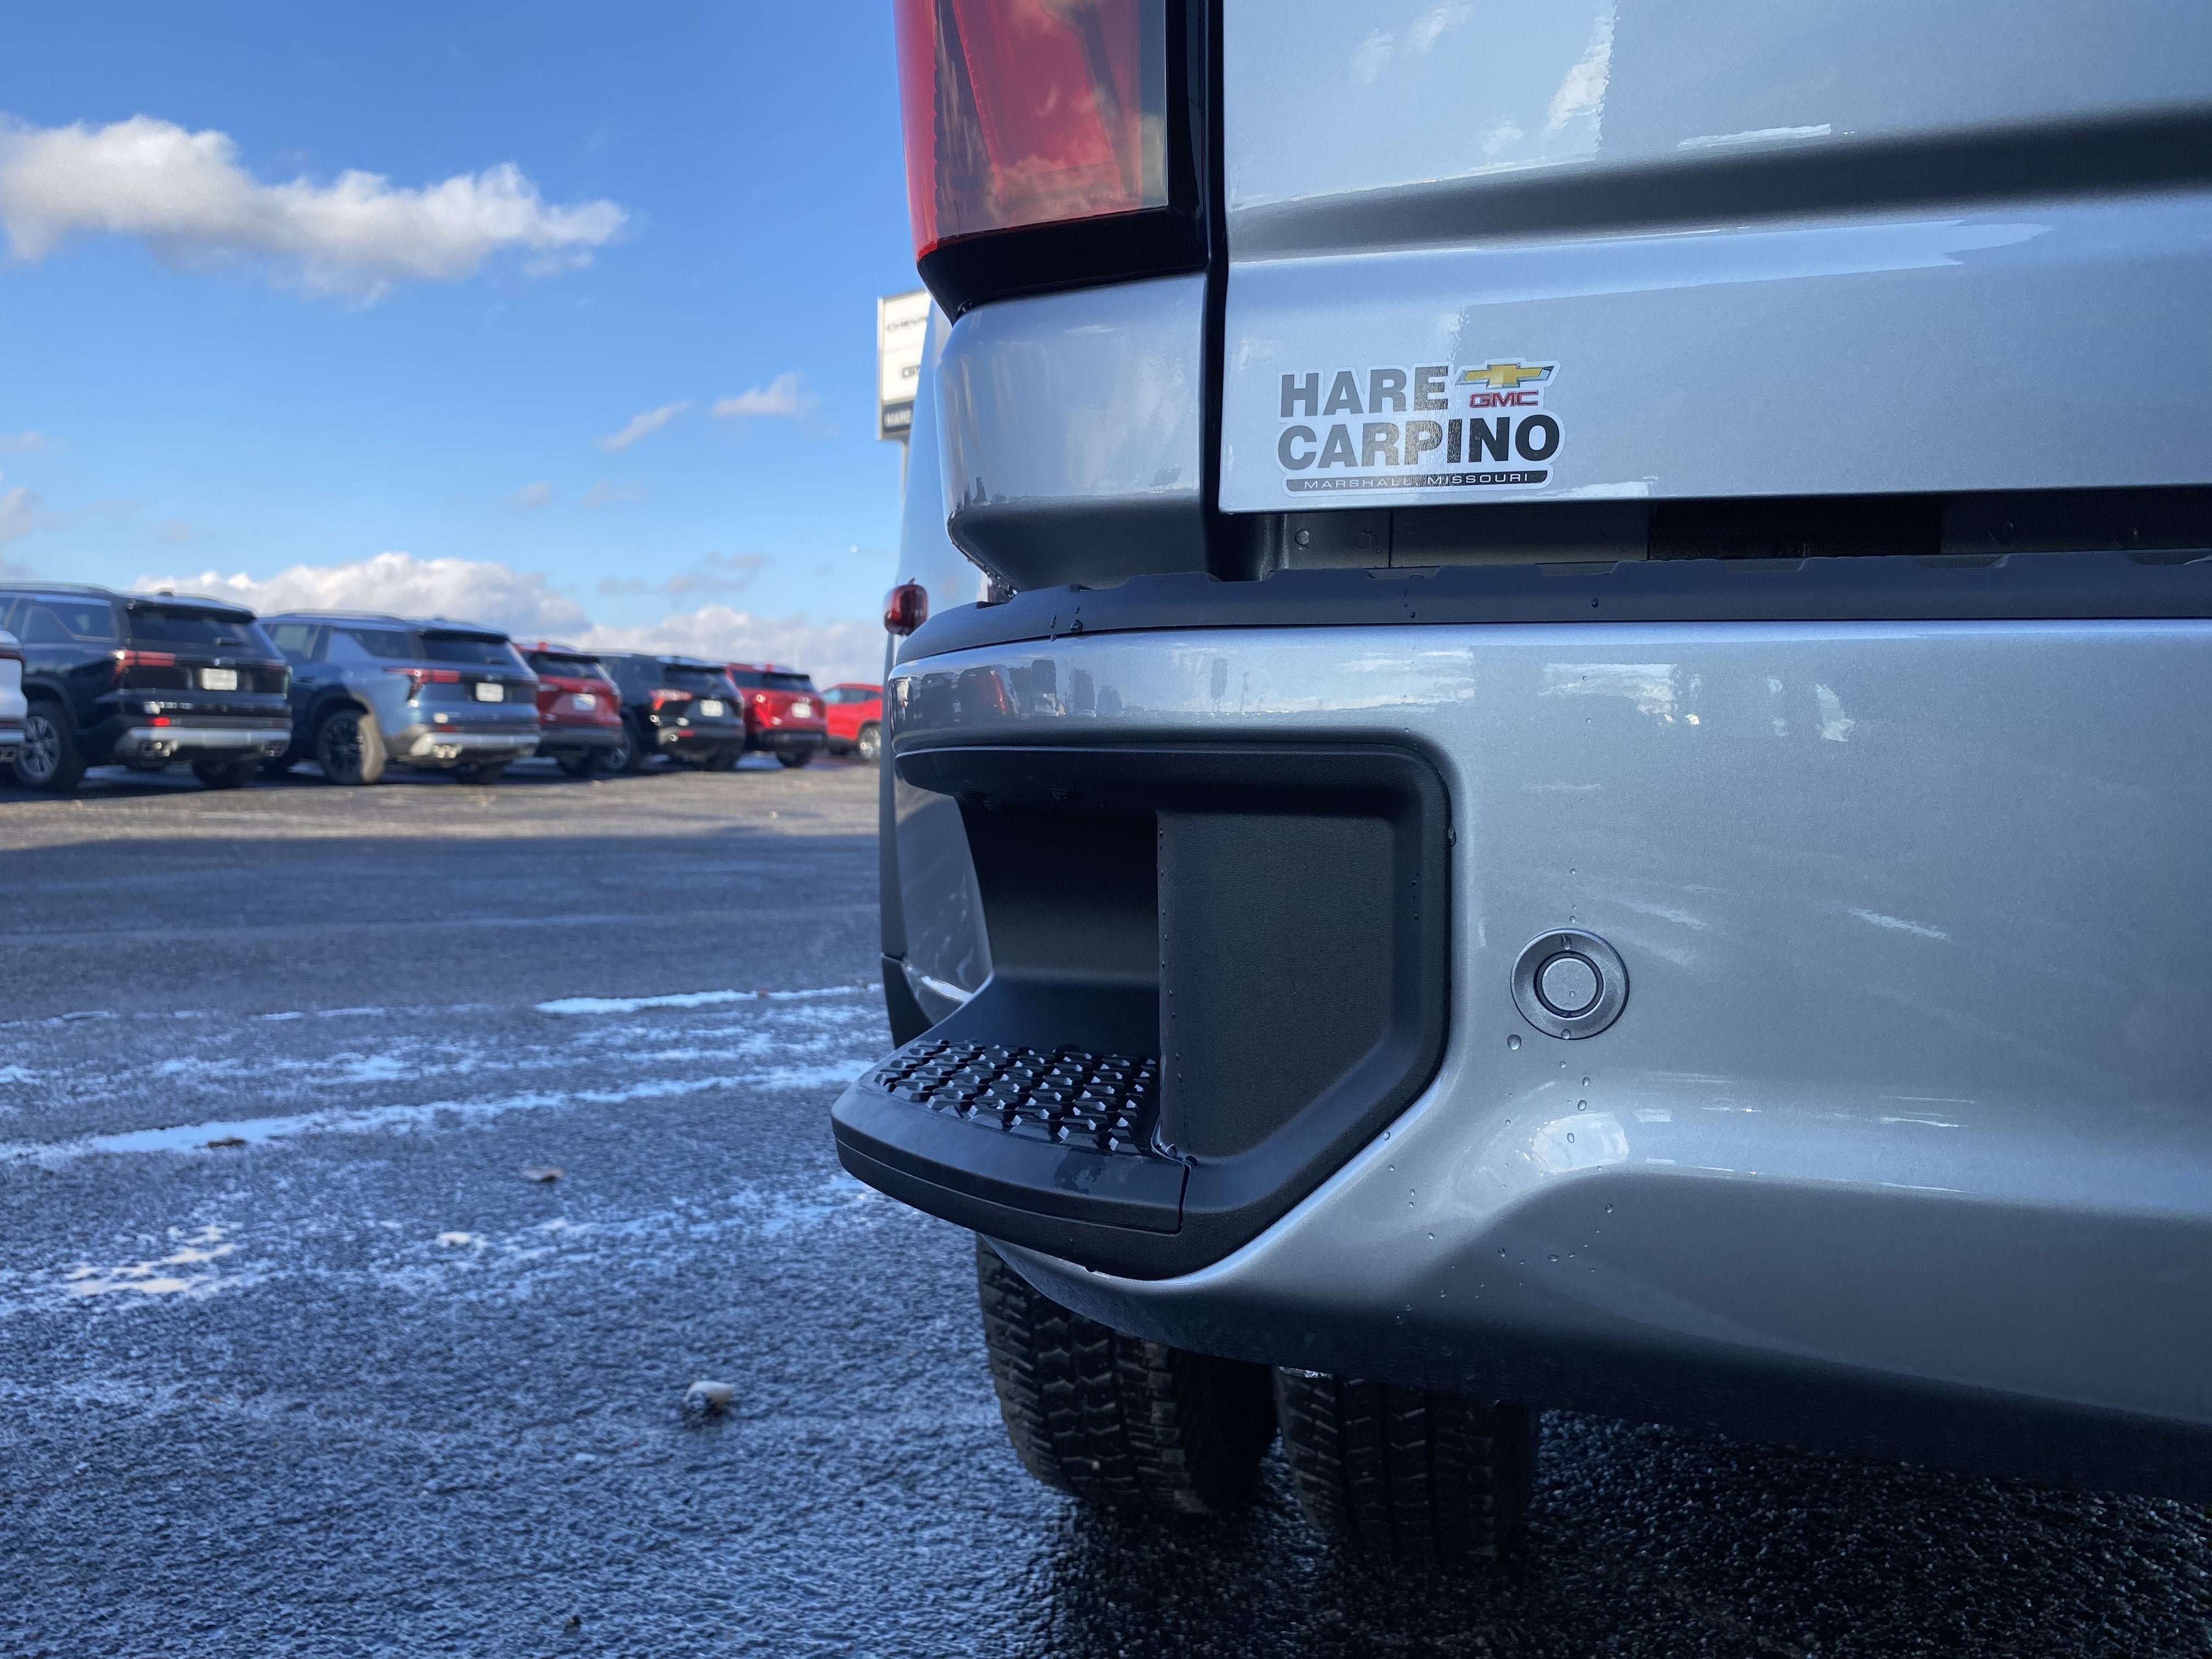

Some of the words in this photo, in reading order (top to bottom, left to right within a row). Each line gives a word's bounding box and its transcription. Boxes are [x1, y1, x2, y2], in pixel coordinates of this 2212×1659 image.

[1280, 365, 1449, 417] HARE
[1469, 390, 1538, 408] GMC
[1278, 414, 1560, 471] CARPINO
[1427, 473, 1528, 485] MISSOURI
